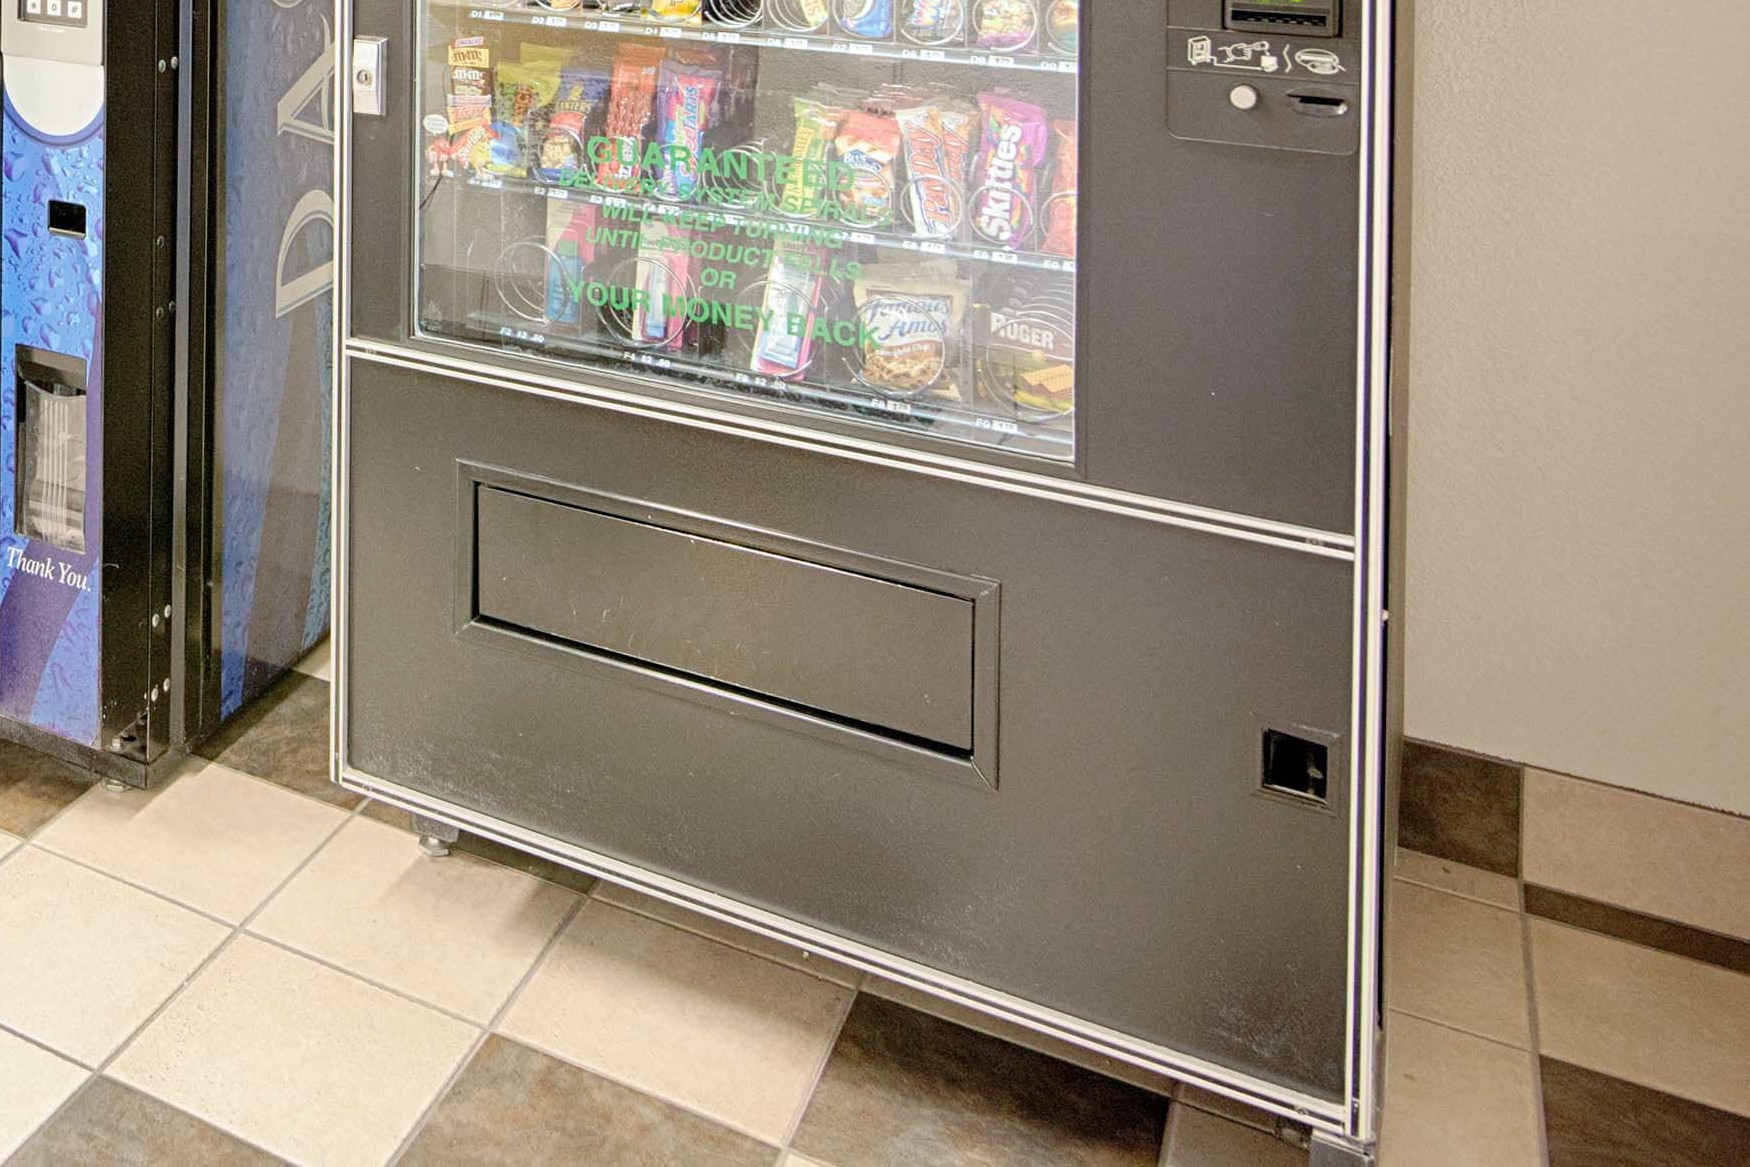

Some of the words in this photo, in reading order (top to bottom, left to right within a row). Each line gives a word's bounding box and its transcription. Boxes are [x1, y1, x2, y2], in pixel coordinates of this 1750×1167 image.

[587, 135, 857, 193] GUARANTEED
[981, 121, 1023, 243] Skittles
[601, 202, 651, 224] WILL
[661, 208, 728, 231] KEEP
[656, 235, 776, 267] PRODUCT
[699, 266, 737, 291] OR
[567, 279, 651, 314] YOUR
[661, 291, 775, 332] MONEY
[786, 311, 884, 351] BACK
[866, 296, 953, 325] Famous
[875, 318, 949, 342] Amos
[991, 312, 1055, 351] RUGER
[6, 544, 55, 582] Thank
[56, 557, 92, 594] You.
